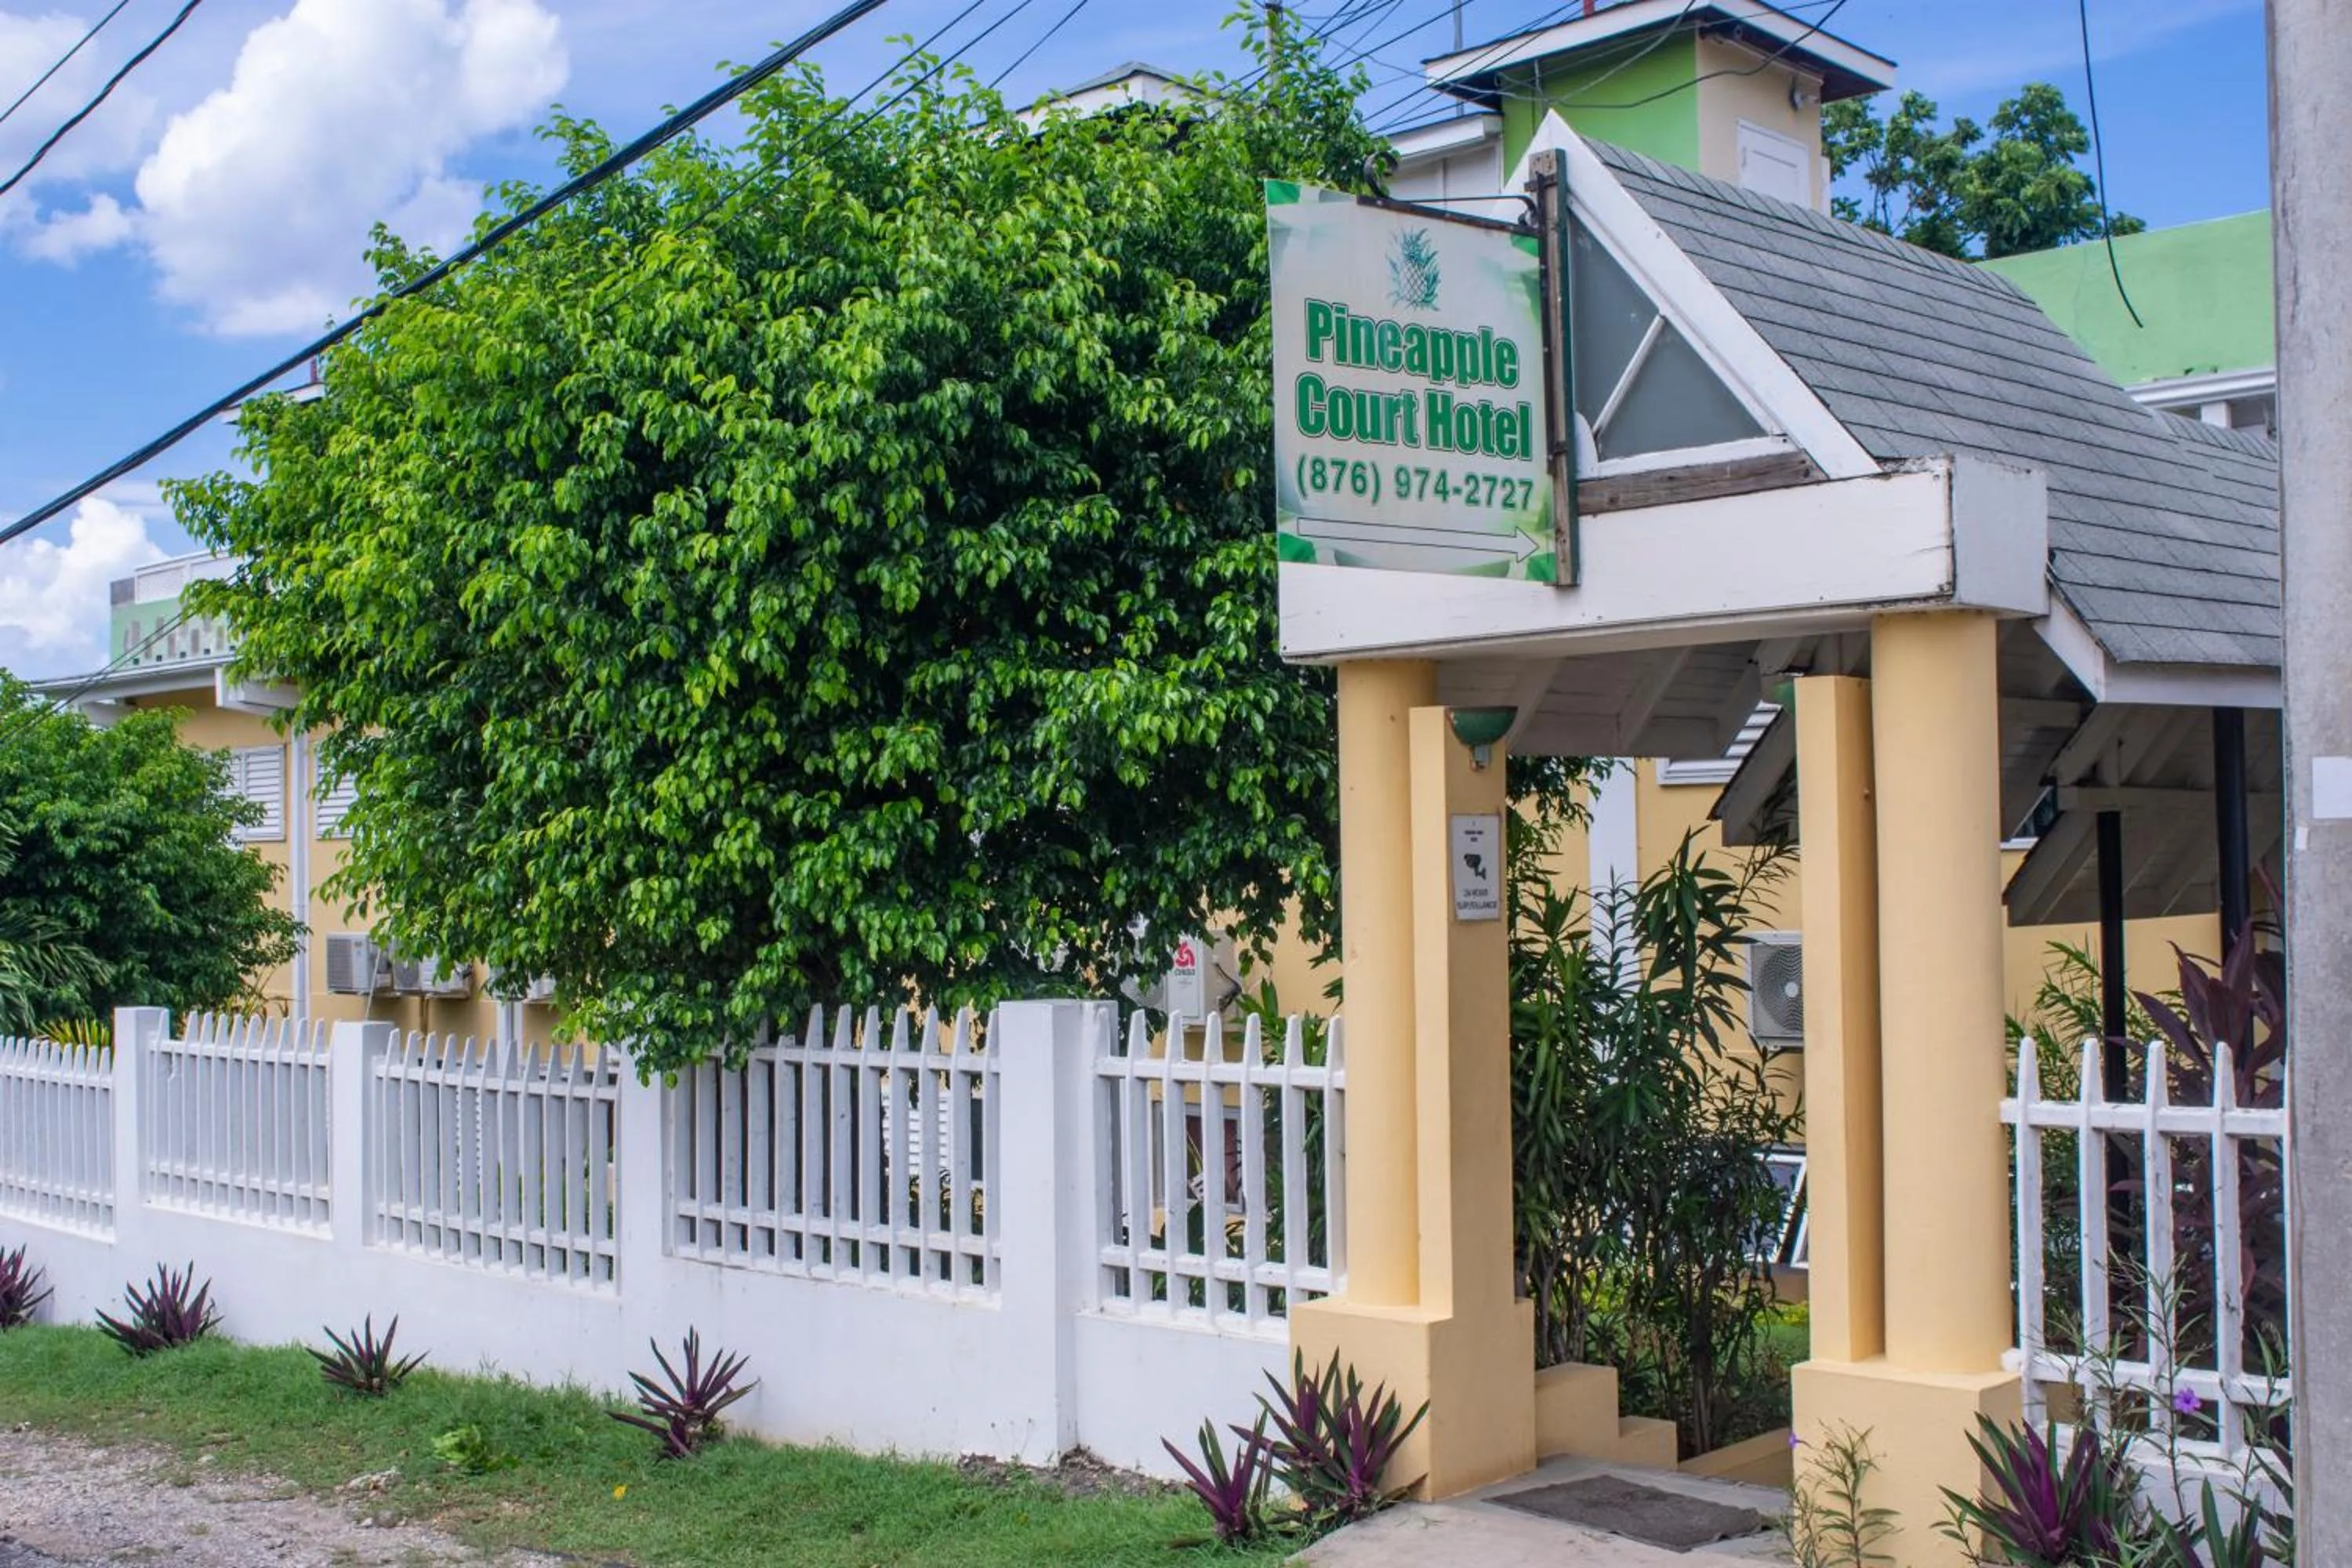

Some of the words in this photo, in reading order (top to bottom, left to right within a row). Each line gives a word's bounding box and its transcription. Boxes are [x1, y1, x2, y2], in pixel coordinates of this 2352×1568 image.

[1305, 298, 1519, 389] Pineapple
[1295, 372, 1419, 449] Court
[1425, 389, 1532, 461] Hotel
[1298, 454, 1381, 503] (876)
[1395, 466, 1534, 511] 974-2727
